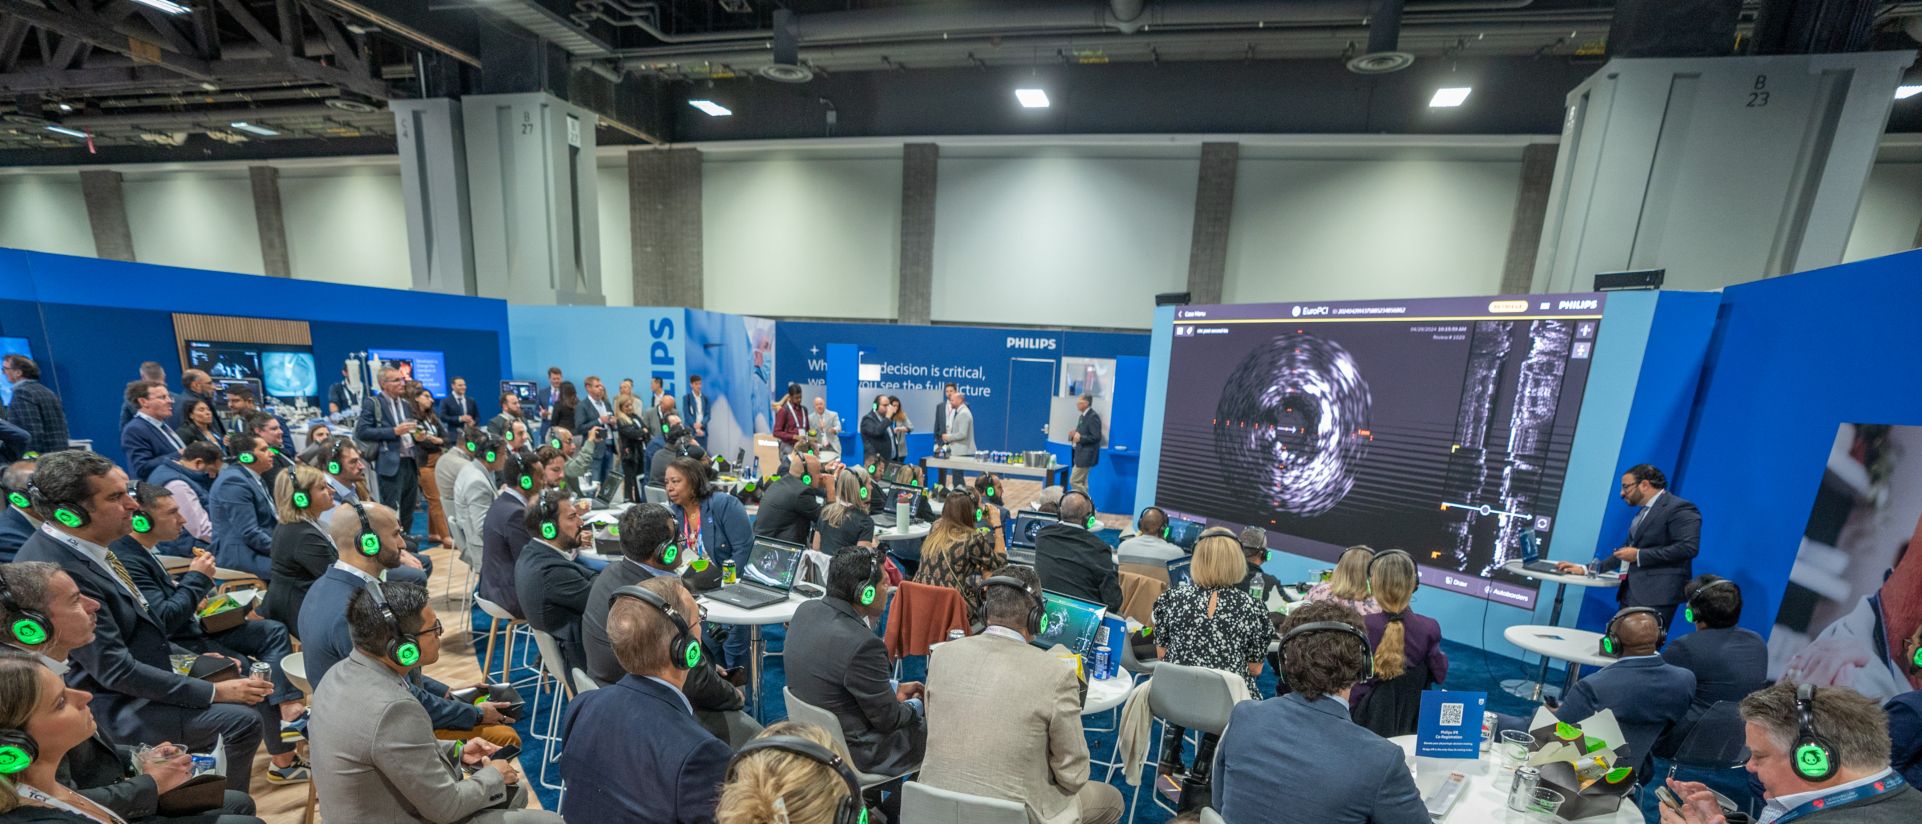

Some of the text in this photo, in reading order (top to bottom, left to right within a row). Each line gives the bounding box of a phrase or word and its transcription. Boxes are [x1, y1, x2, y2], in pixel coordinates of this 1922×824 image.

[1753, 74, 1767, 90] B
[1746, 91, 1770, 108] 23
[523, 111, 530, 122] B
[521, 124, 534, 135] 27
[1558, 300, 1598, 310] PHILIPS
[1006, 336, 1057, 350] PHILIPS
[808, 359, 986, 381] Wh decision is critical,
[880, 381, 900, 390] see
[903, 380, 921, 391] the
[956, 383, 991, 397] icture
[1493, 588, 1529, 602] Autoborders
